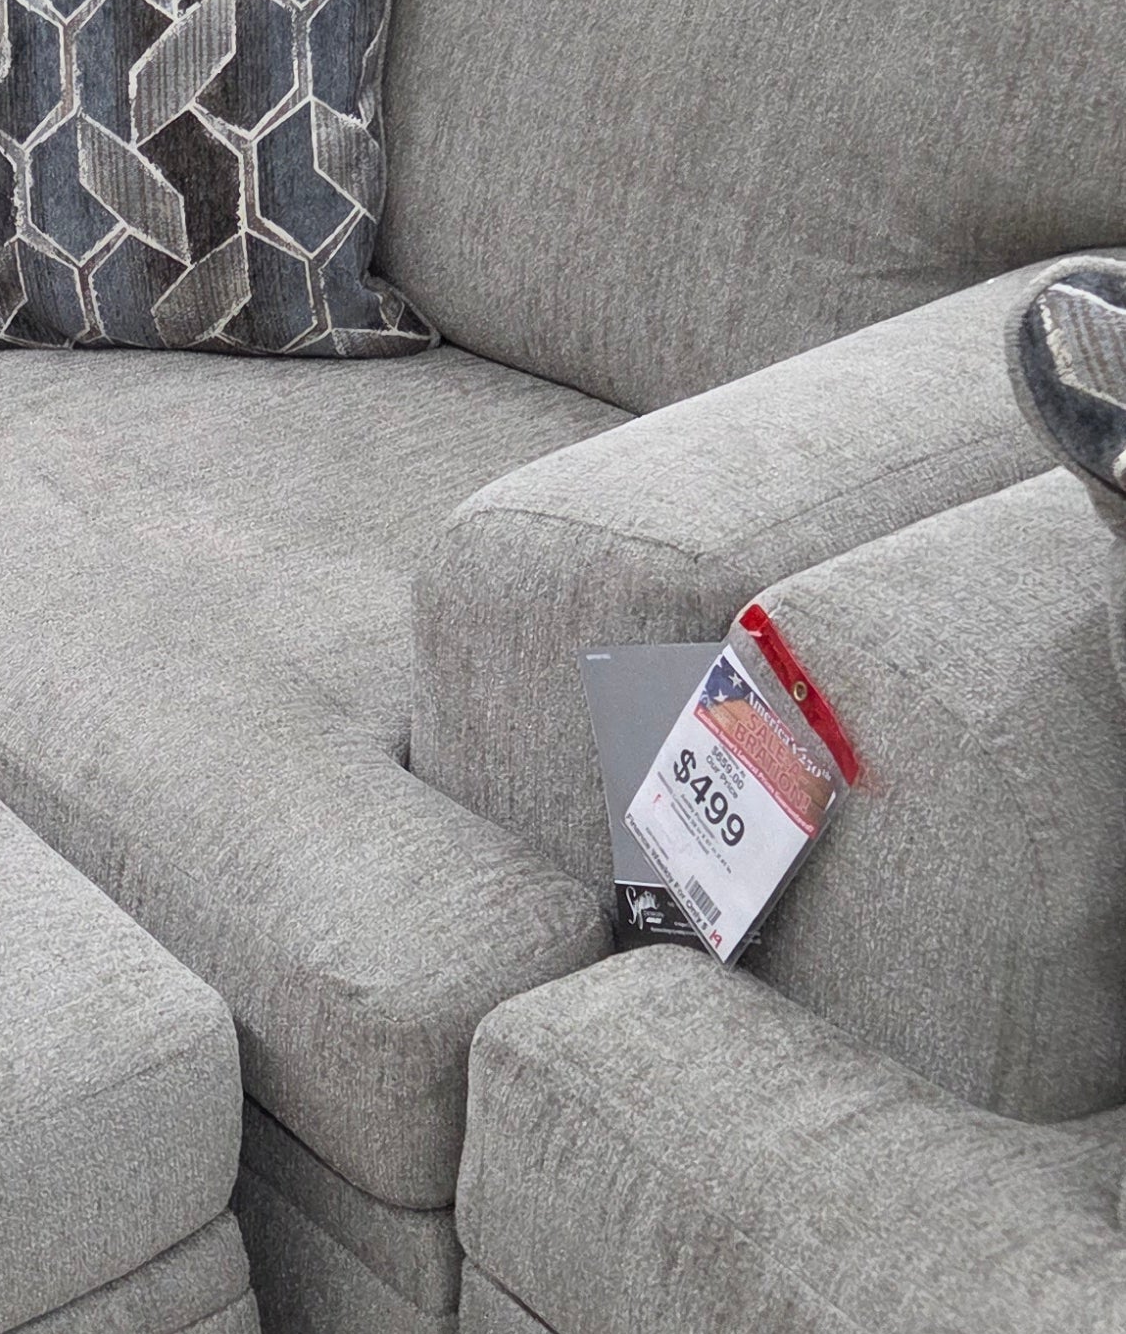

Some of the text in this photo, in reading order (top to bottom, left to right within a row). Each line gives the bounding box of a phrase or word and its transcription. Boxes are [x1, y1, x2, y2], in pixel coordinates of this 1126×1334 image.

[673, 748, 746, 847] $499
[706, 755, 739, 799] Our Price
[711, 745, 744, 790] $659.00
[733, 722, 811, 813] BRATION!
[649, 847, 675, 884] Weekly
[672, 879, 687, 900] For
[684, 896, 702, 923] Only
